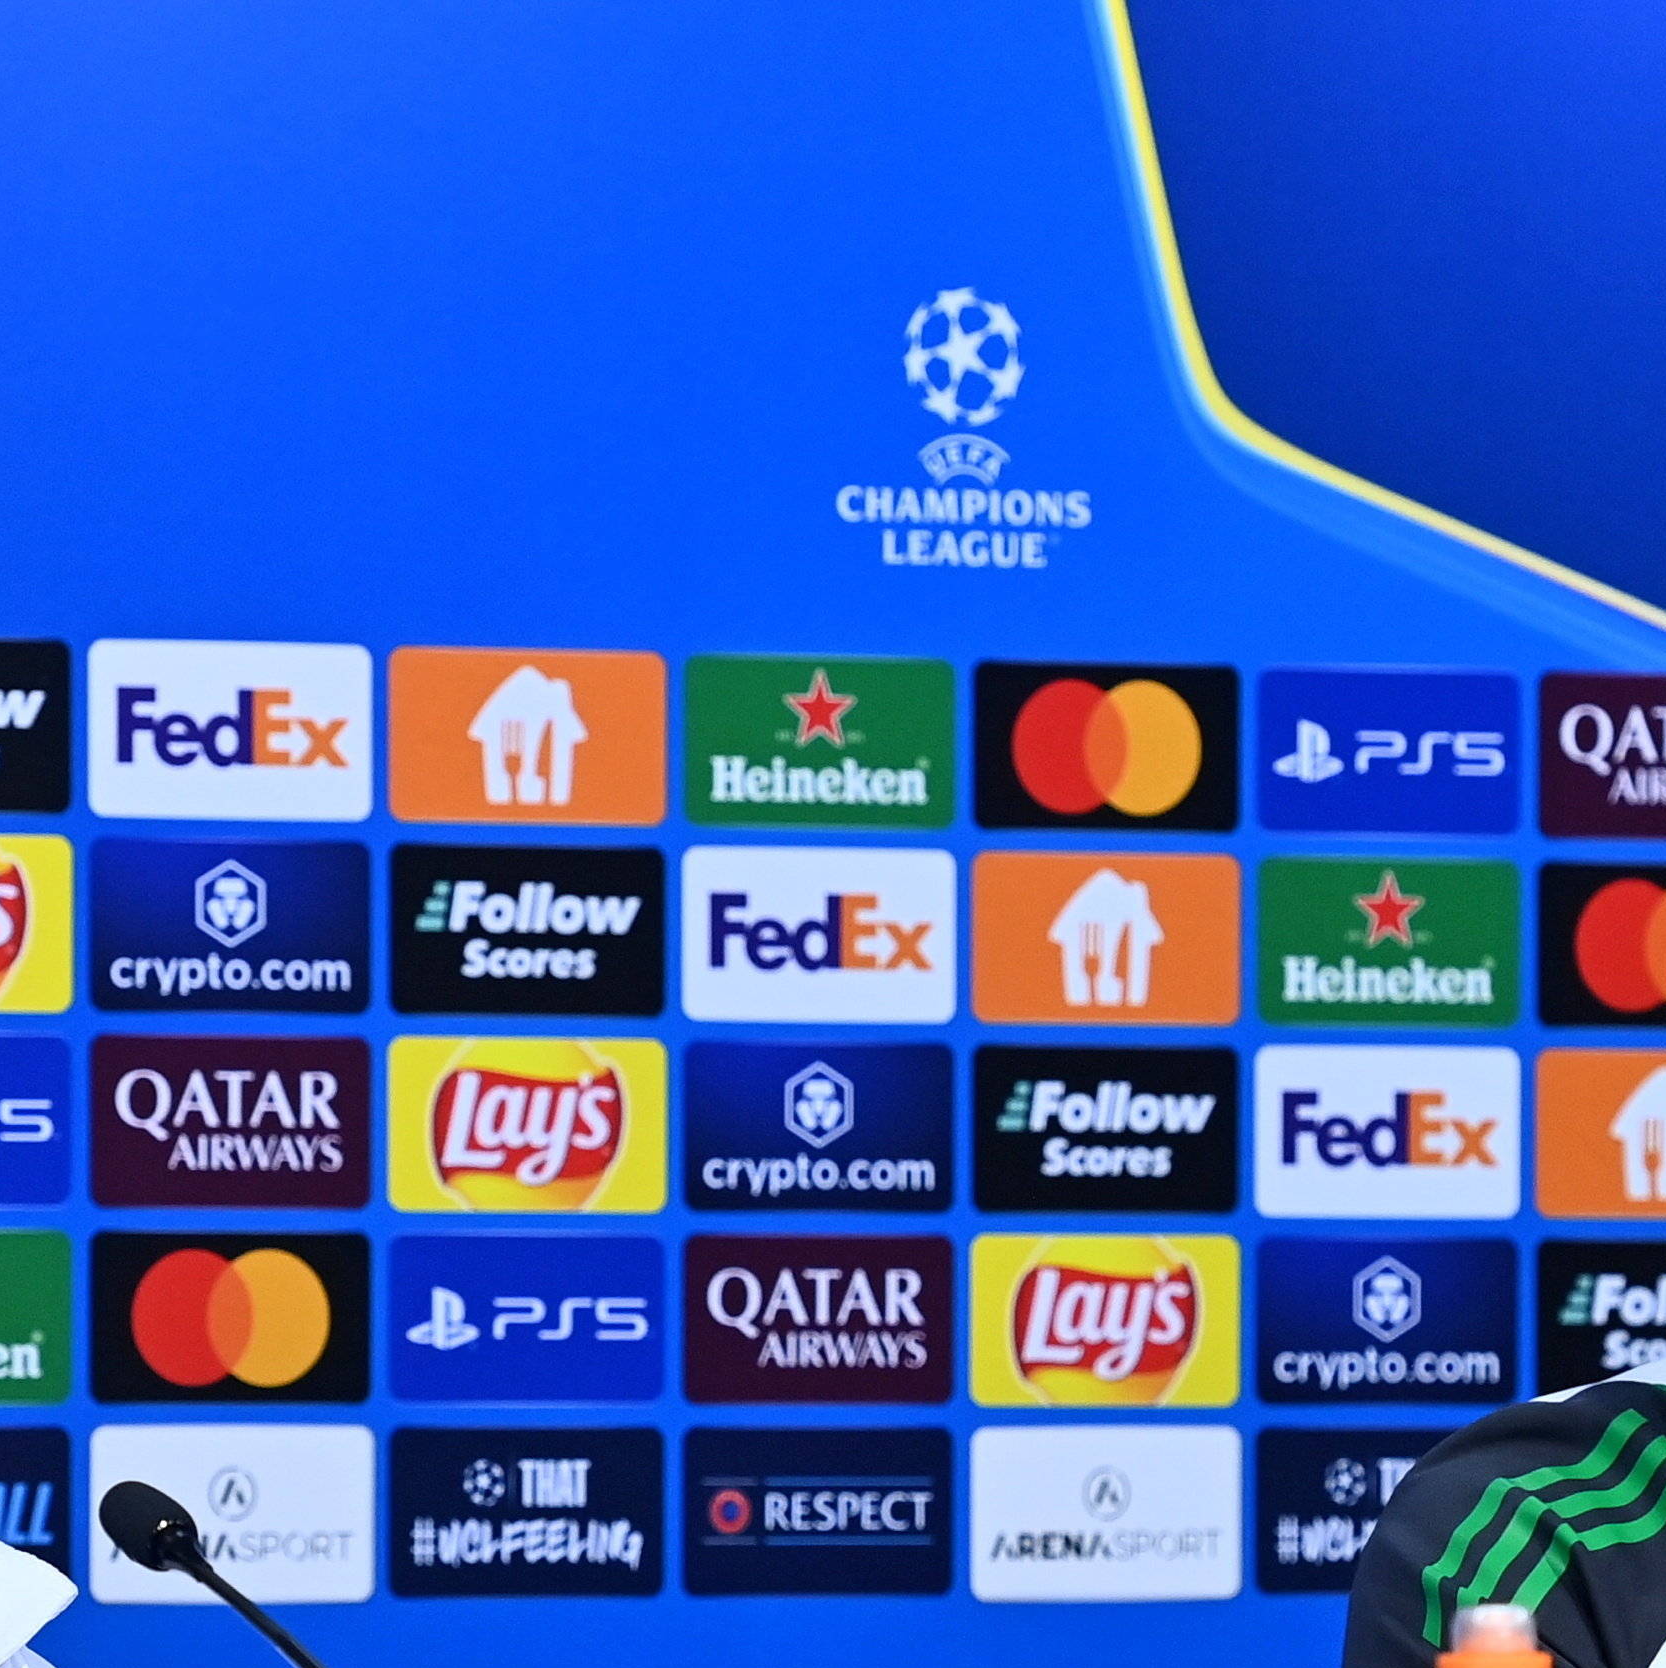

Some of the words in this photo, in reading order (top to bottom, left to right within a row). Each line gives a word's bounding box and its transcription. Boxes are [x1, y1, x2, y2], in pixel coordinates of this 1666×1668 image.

[921, 443, 1007, 480] UEFA
[836, 485, 1091, 528] CHAMPIONS
[883, 529, 1047, 568] LEAGUE
[117, 686, 349, 767] FedEx
[1354, 730, 1505, 776] PS5
[711, 755, 928, 805] Heineken
[449, 881, 640, 934] Follow
[709, 892, 932, 972] FedEx
[110, 953, 351, 996] crypto.com
[461, 939, 596, 979] Scores
[1283, 956, 1493, 1004] Heineken
[115, 1069, 339, 1141] QATAR
[442, 1072, 614, 1184] Lay's
[1029, 1081, 1215, 1133] Follow
[1282, 1091, 1497, 1168] FedEx
[168, 1134, 343, 1172] AIRWAYS
[703, 1153, 935, 1196] crypto.com
[1041, 1137, 1171, 1177] Scores
[493, 1297, 648, 1340] PS5
[707, 1268, 924, 1339] QATAR
[1021, 1267, 1189, 1379] Lay's
[758, 1331, 927, 1368] AIRWAYS
[1273, 1346, 1500, 1390] crypto.com
[518, 1459, 591, 1507] THAT
[765, 1491, 932, 1531] RESPECT
